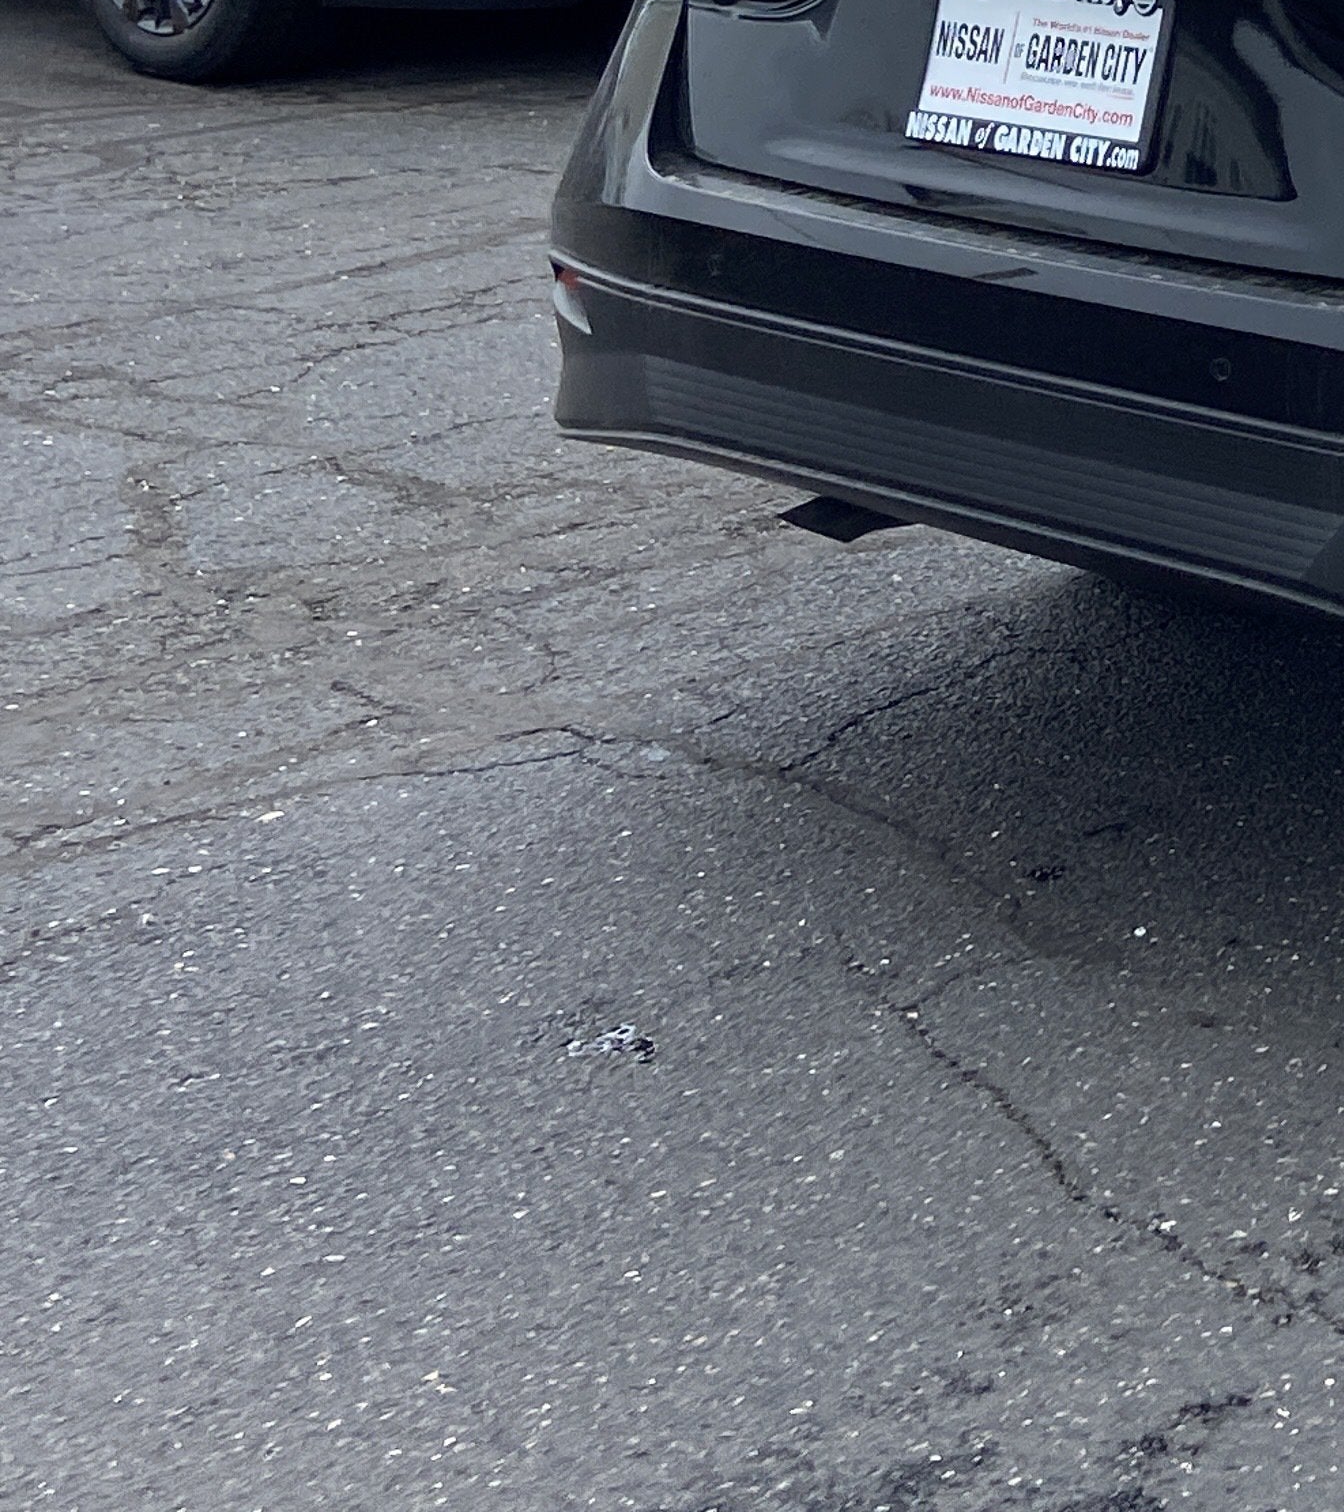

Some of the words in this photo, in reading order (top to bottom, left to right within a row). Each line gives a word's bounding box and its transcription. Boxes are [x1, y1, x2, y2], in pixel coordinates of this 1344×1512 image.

[935, 20, 1005, 65] NISSAN
[1025, 32, 1101, 79] GARDEN
[1100, 43, 1147, 85] CITY
[905, 110, 973, 147] NISSAN
[974, 121, 995, 150] of
[993, 124, 1068, 161] GARDEN
[1069, 140, 1140, 171] CITY.com
